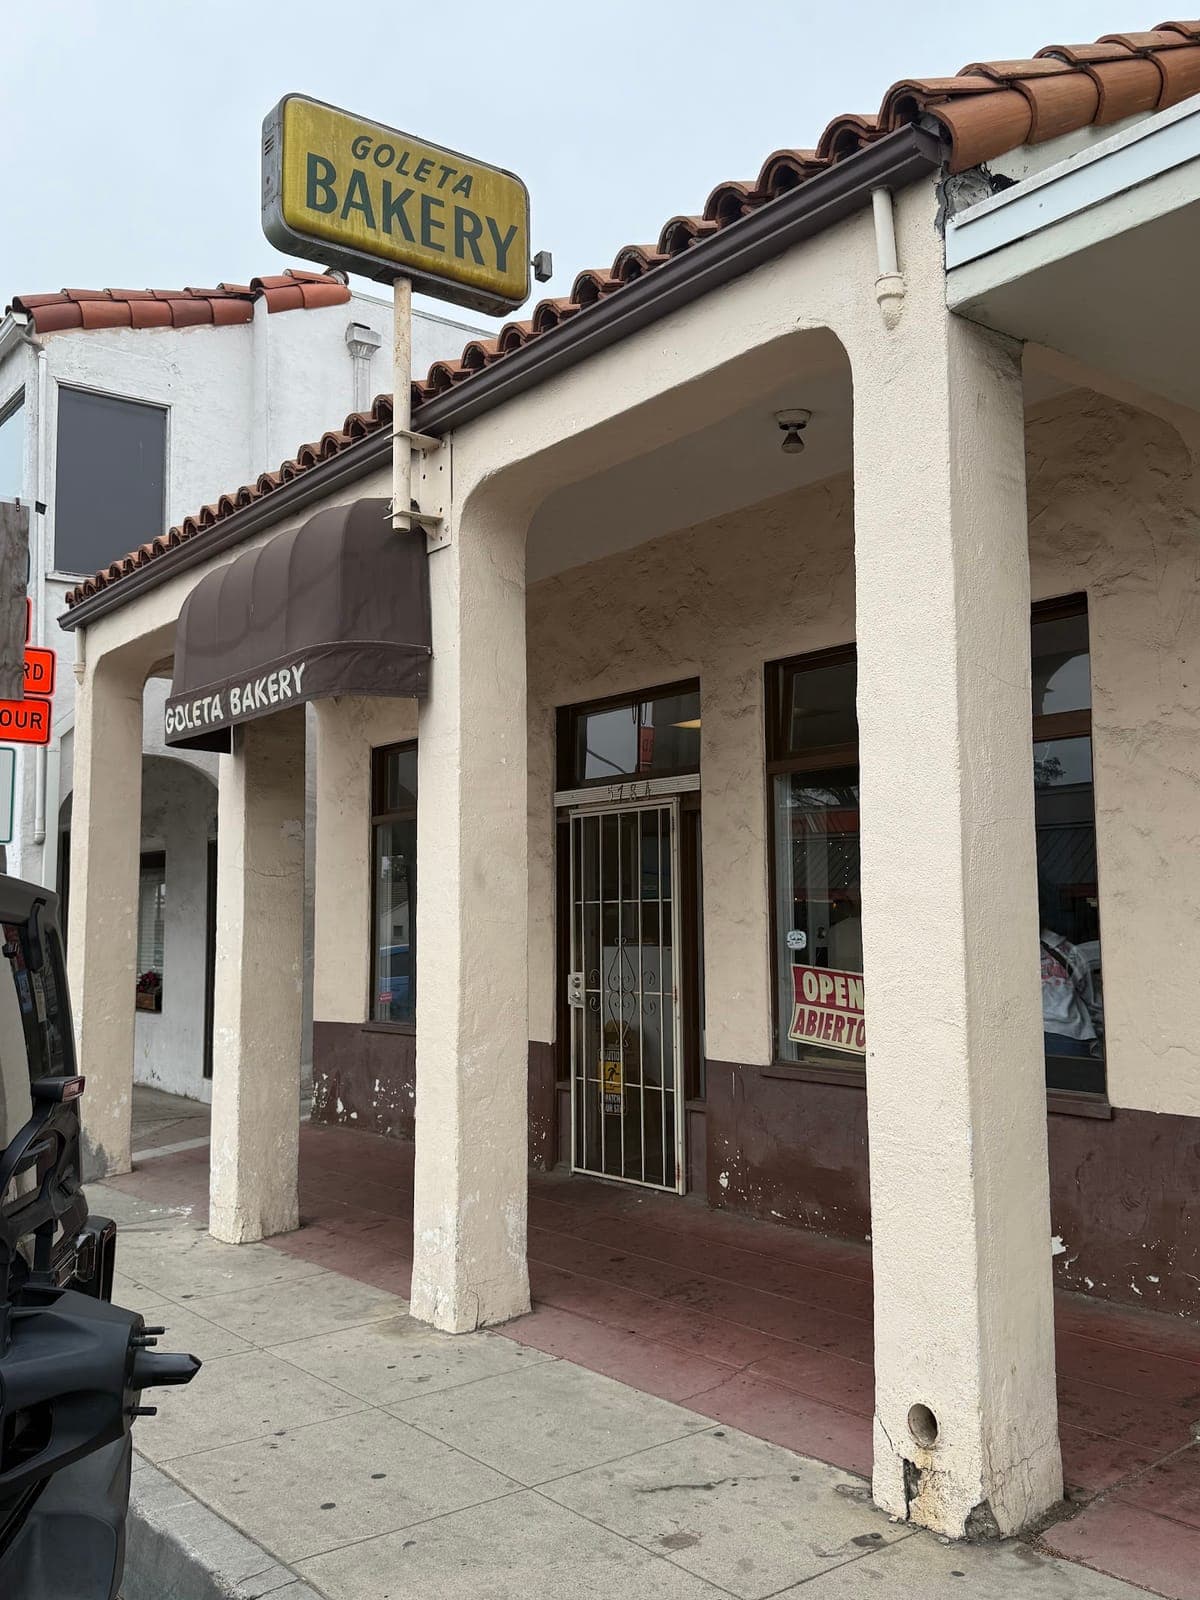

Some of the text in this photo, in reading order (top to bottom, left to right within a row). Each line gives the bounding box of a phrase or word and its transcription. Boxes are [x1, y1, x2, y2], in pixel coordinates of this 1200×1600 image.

[351, 135, 474, 199] GOLETA
[305, 151, 519, 274] BAKERY
[165, 662, 305, 734] GOLETA BAKERY
[802, 971, 864, 1011] OPEN
[793, 1007, 866, 1047] ABIERTO
